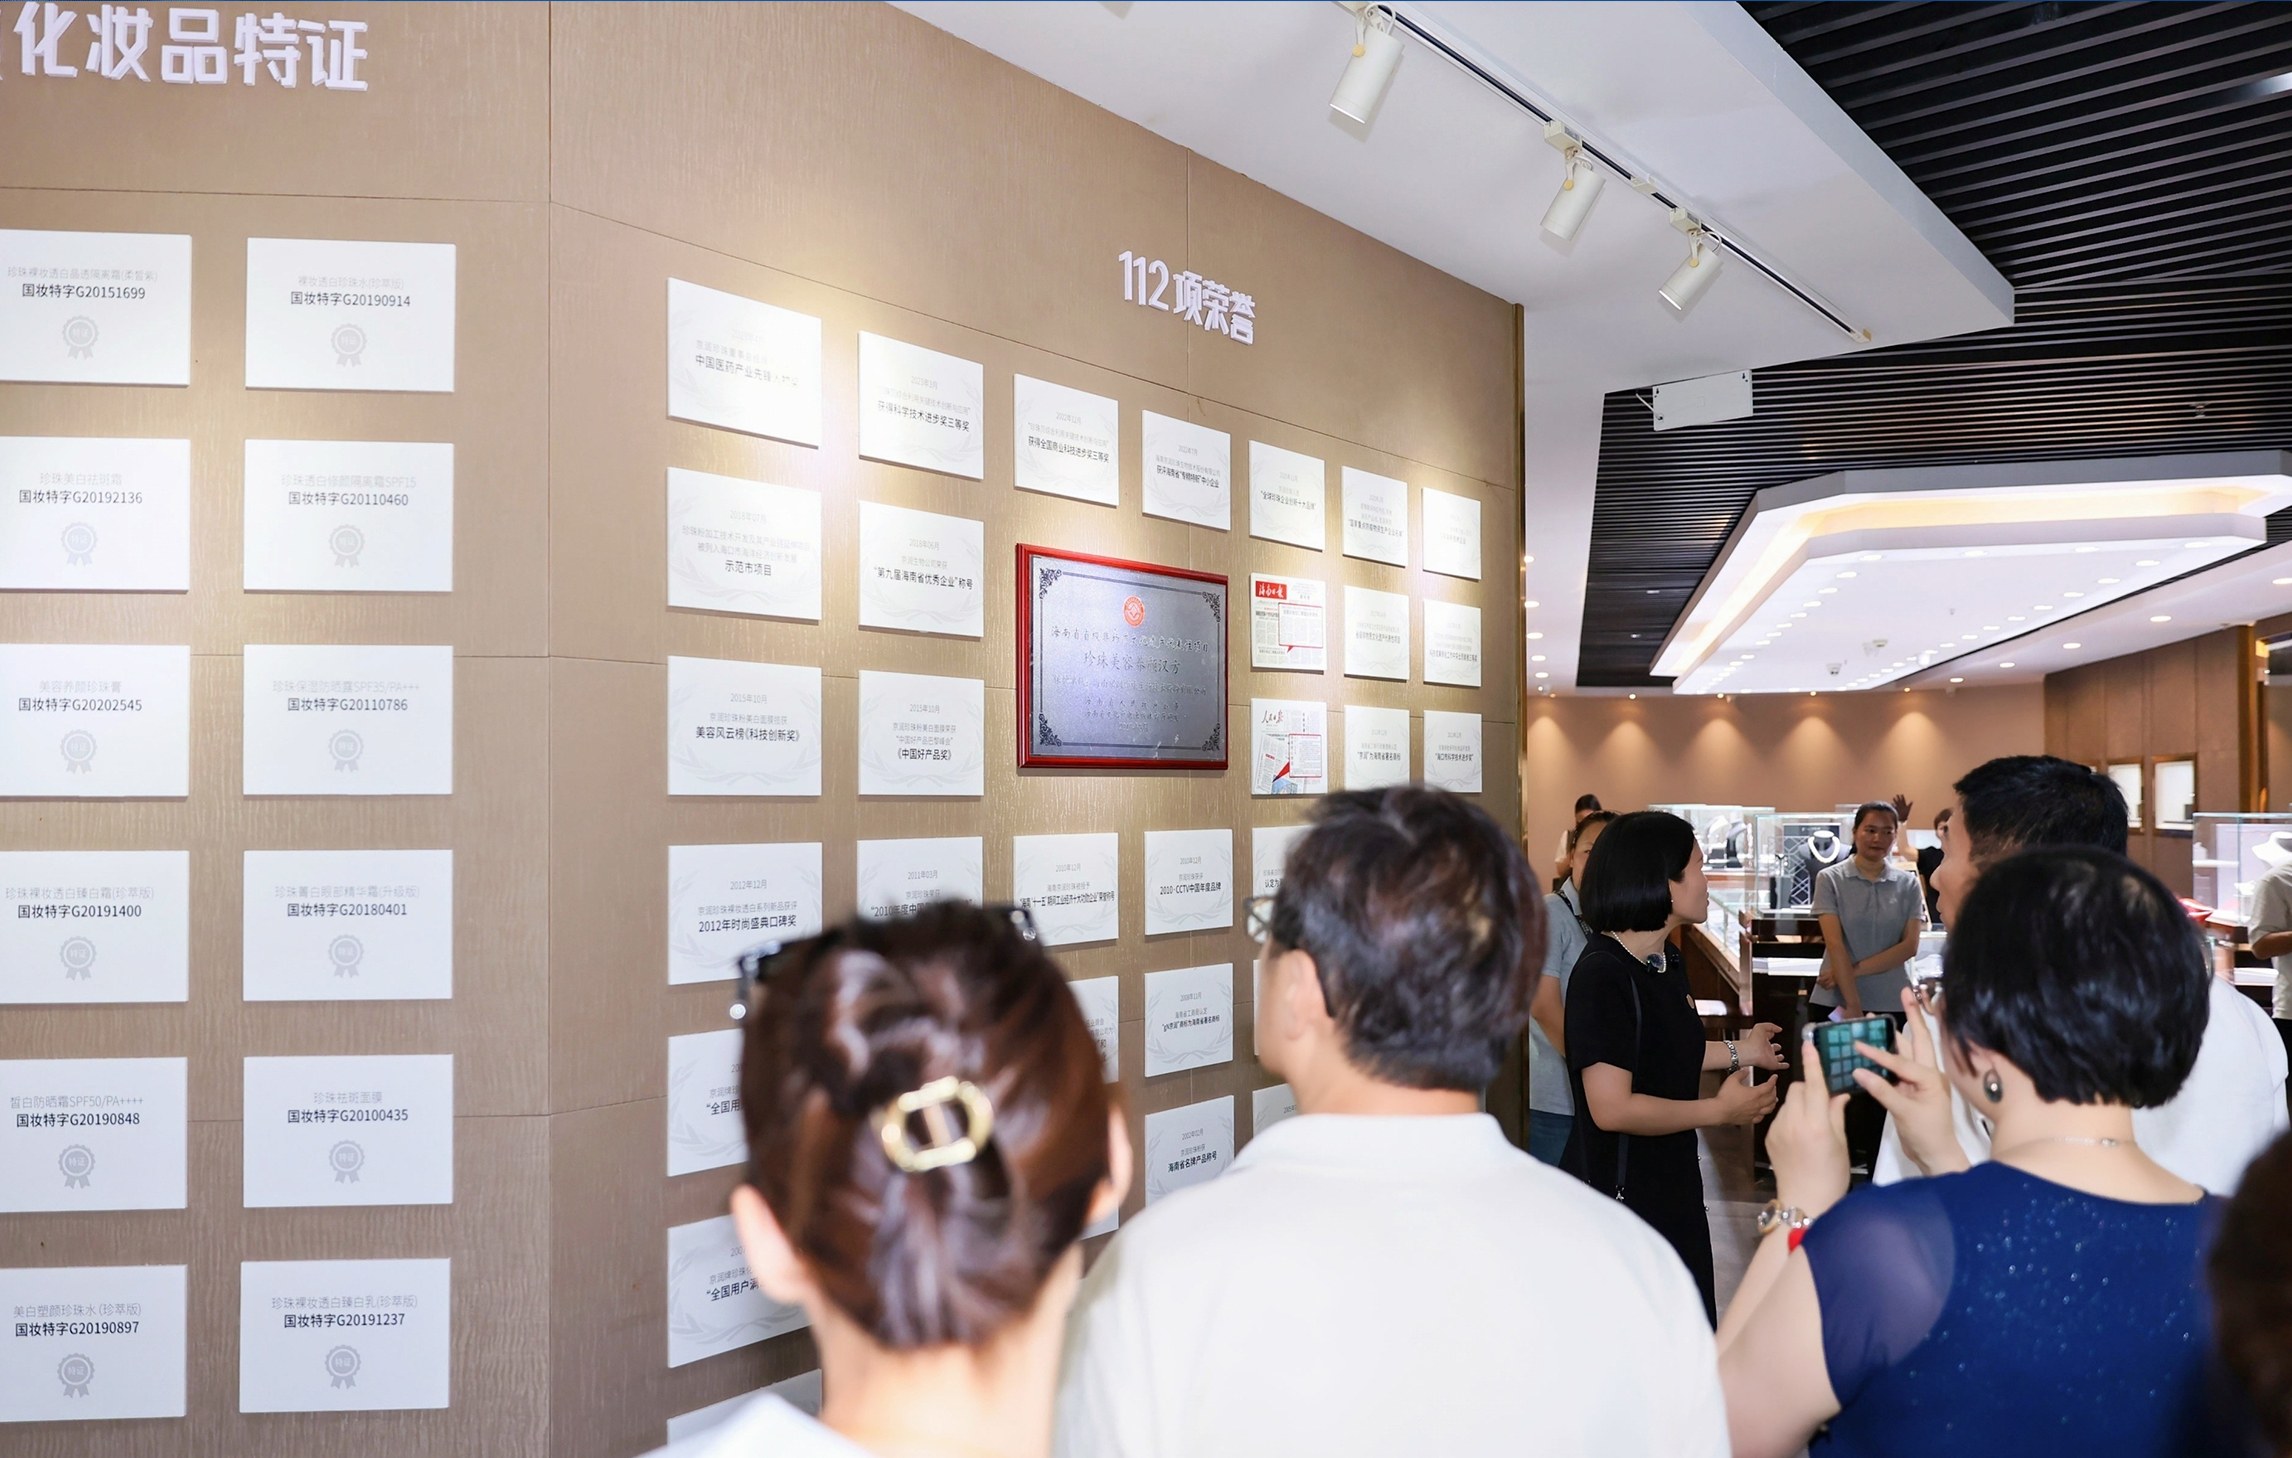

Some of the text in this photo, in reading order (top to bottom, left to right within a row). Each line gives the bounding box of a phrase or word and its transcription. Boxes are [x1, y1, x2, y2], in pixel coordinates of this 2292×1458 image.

[0, 0, 368, 91] 化妆品特证
[22, 283, 146, 299] 国妆特字G20151699
[291, 291, 411, 306] 国妆特字G20190914
[1118, 250, 1256, 345] 112项荣誉
[19, 490, 143, 504] 国妆特字G20192136
[289, 491, 409, 506] 国妆特字G20110460
[725, 559, 773, 577] 示范市项目
[873, 566, 974, 591] “第九届海南省优秀企业”称号
[18, 697, 143, 711] 国妆特字G20202545
[287, 697, 409, 711] 国妆特字G20110786
[730, 692, 768, 705] 2015年10月
[695, 726, 801, 742] 美容风云榜《科技创新奖》
[897, 748, 953, 761] 《中国好产品奖》
[729, 878, 768, 891] 2012年12月
[17, 904, 142, 919] 国妆特字G20191400
[287, 903, 408, 917] 国妆特字G20180401
[698, 914, 798, 933] 2012年时尚盛典口碑奖
[709, 1085, 741, 1099] 京润牌珍
[706, 1097, 744, 1116] “全国用
[16, 1113, 141, 1128] 国妆特字G20190848
[287, 1109, 409, 1124] 国妆特字G20100435
[1167, 1149, 1218, 1173] 海南省名牌产品称号
[706, 1278, 762, 1301] “全国用户满
[283, 1313, 406, 1329] 国妆特字G20191237
[14, 1321, 140, 1338] 国妆特字G20190897
